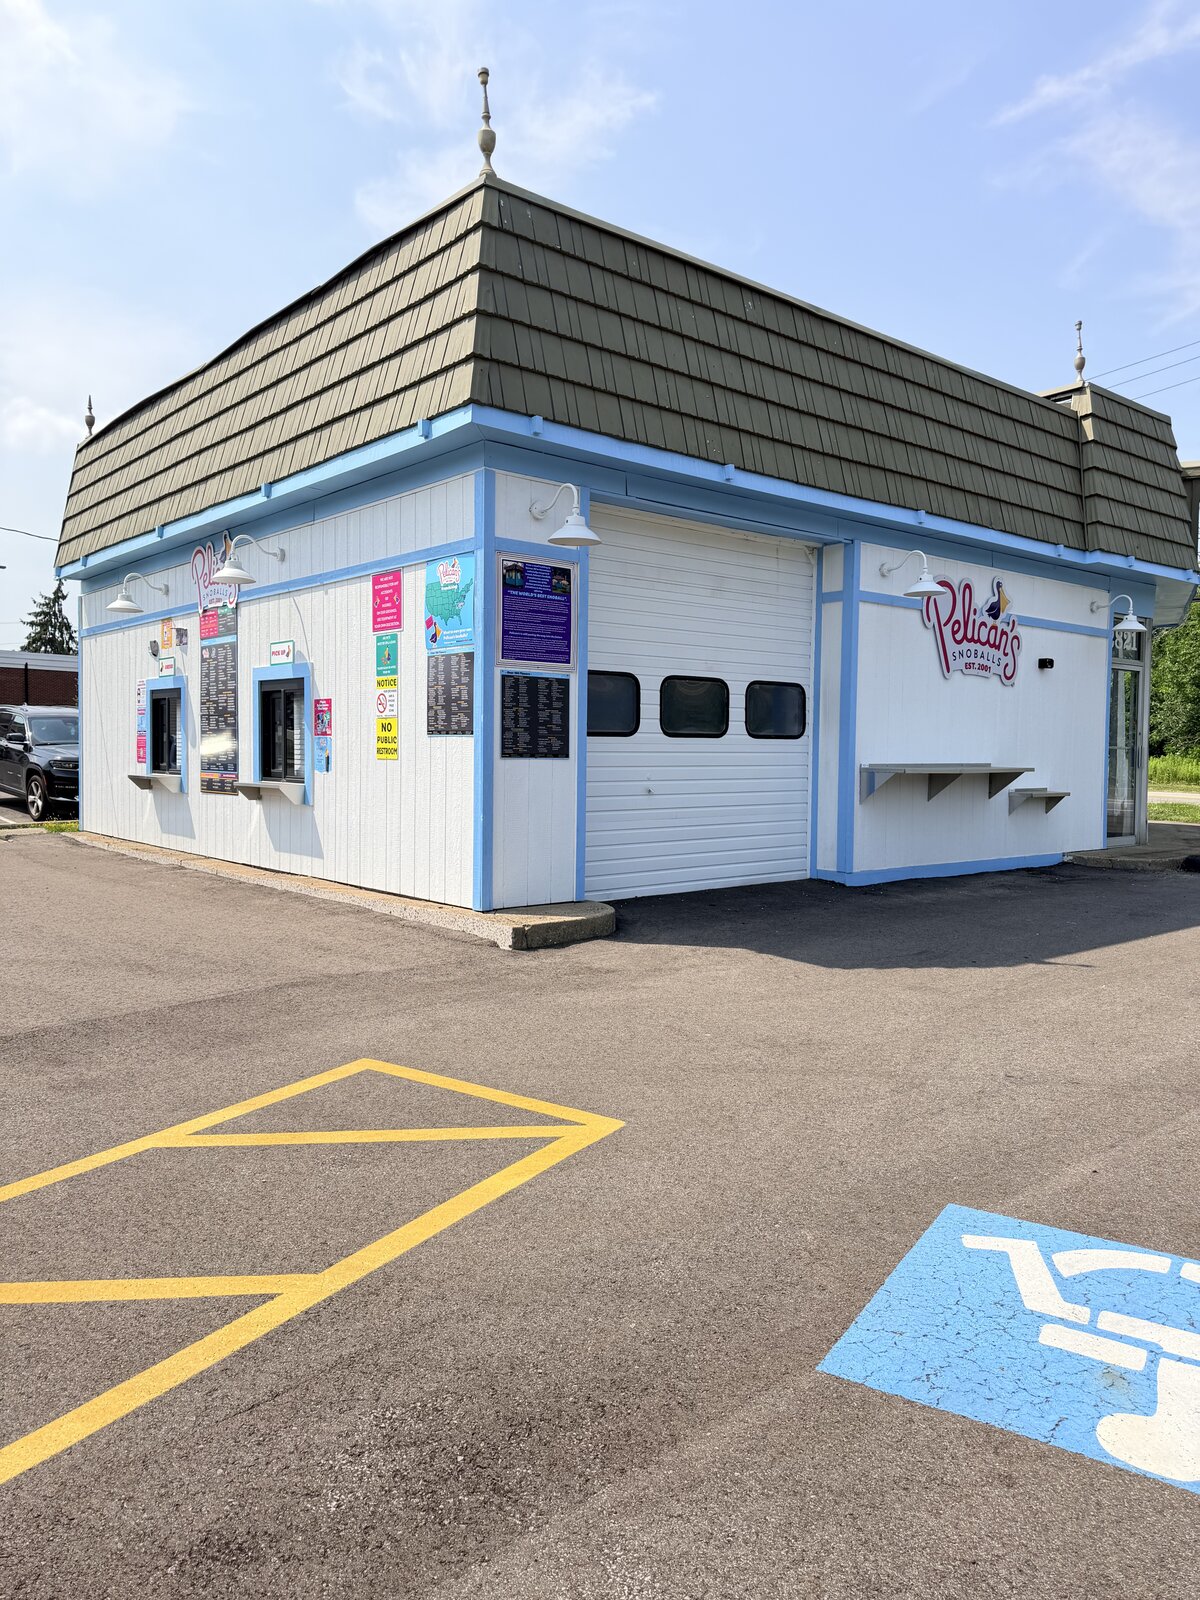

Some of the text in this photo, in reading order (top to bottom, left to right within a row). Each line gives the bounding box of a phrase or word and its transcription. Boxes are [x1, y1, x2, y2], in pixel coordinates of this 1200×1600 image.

[202, 589, 228, 600] SNOBALLS
[926, 580, 1020, 680] Pelican's
[952, 648, 1001, 667] SNOBALLS
[977, 663, 991, 673] 2001
[377, 678, 397, 688] NOTICE
[381, 722, 392, 732] NO
[377, 736, 397, 744] PUBLIC
